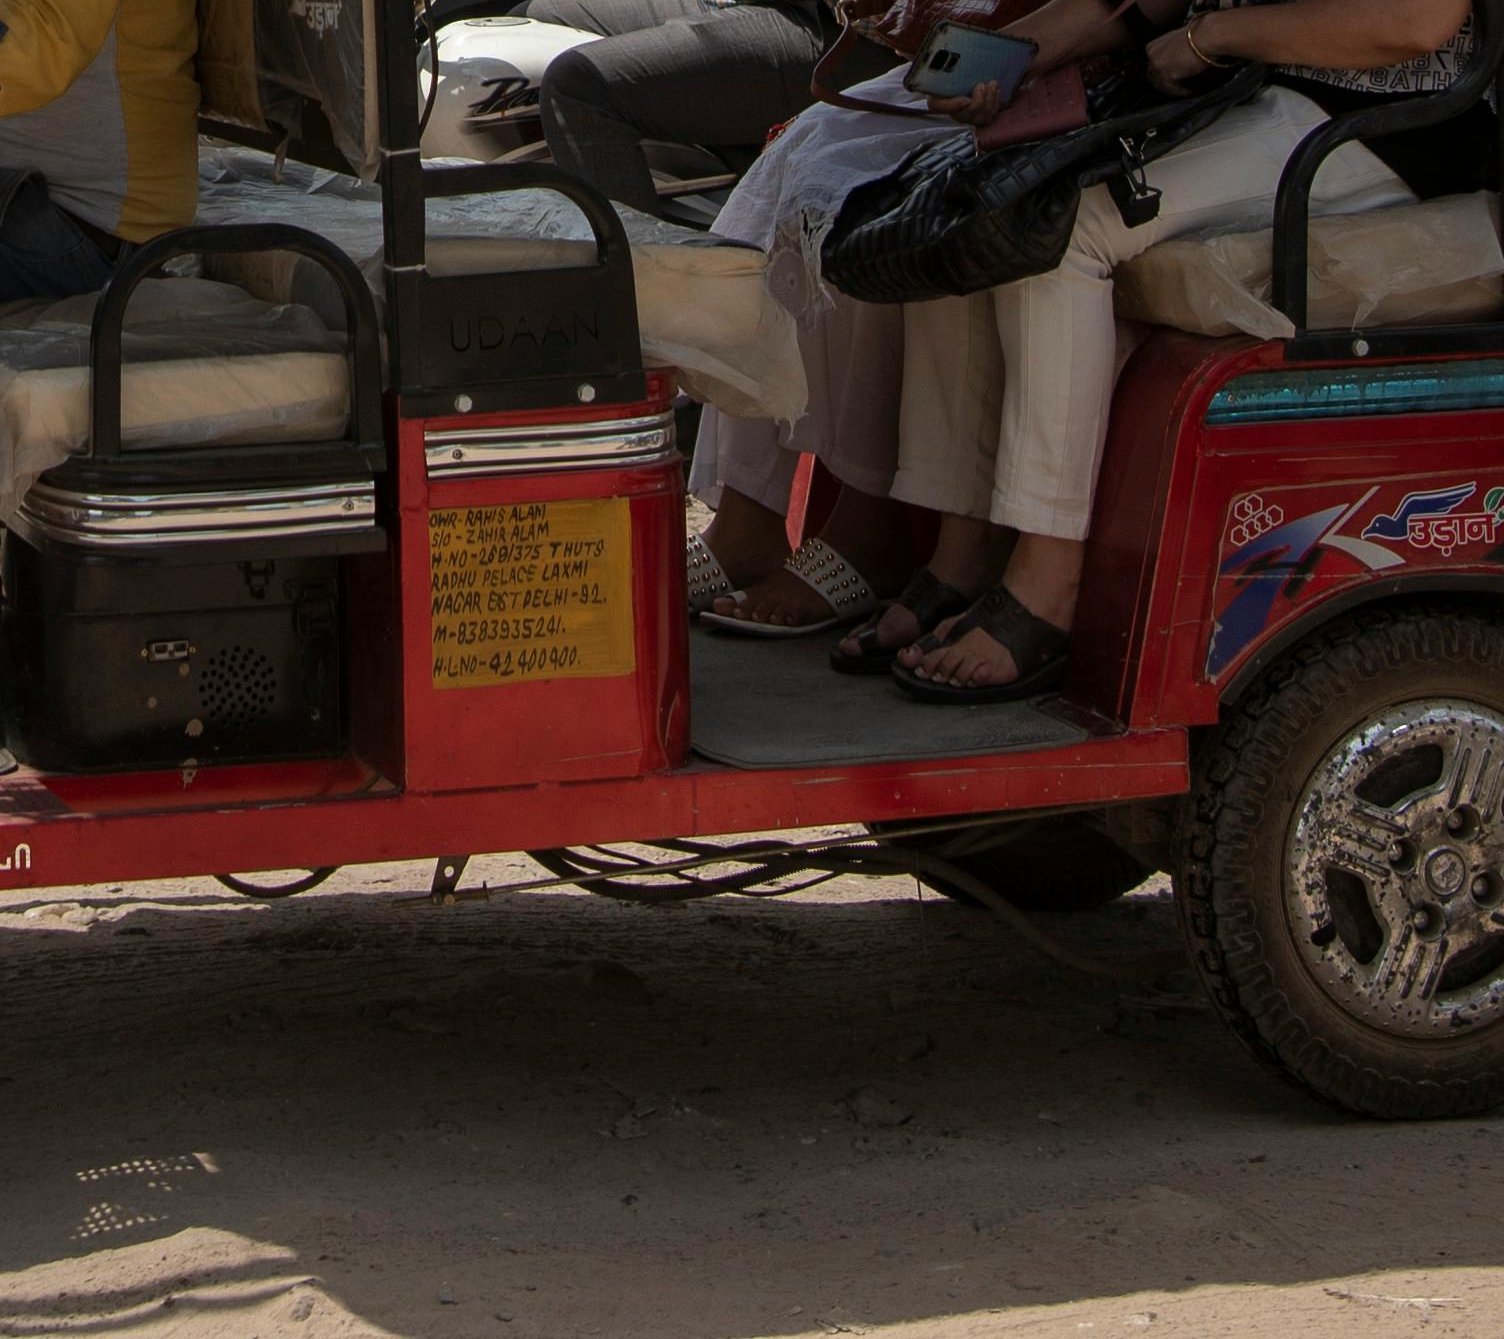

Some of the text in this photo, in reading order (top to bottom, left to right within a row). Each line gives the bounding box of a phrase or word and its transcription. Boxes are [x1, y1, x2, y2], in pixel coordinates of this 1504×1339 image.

[465, 507, 506, 526] RAHIS
[509, 504, 546, 522] ALAM
[466, 527, 507, 544] ZAHIR
[510, 522, 550, 542] ALAM
[1407, 510, 1498, 557] उड़ान
[431, 570, 477, 593] RADHU
[542, 560, 589, 581] LAXMI
[431, 592, 482, 616] NAGAR
